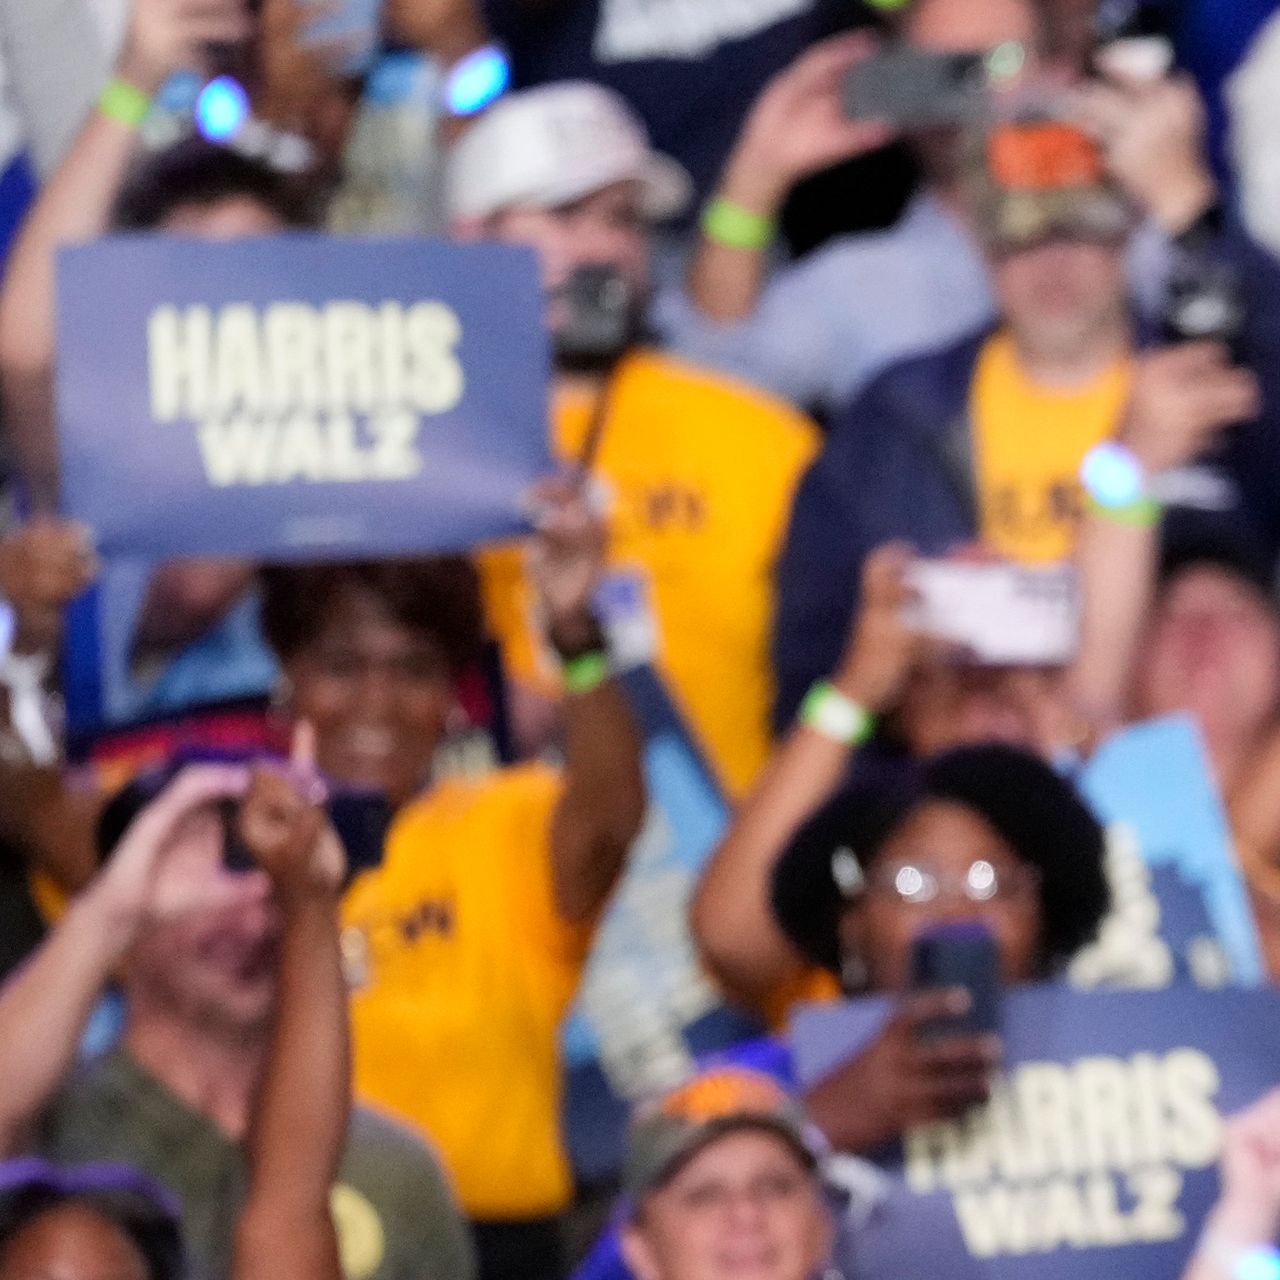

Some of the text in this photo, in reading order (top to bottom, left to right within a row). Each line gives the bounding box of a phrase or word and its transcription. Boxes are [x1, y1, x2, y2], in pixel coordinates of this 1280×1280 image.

[148, 300, 466, 424] HARRIS
[200, 412, 423, 487] WALZ
[953, 1165, 1186, 1258] WALZ
